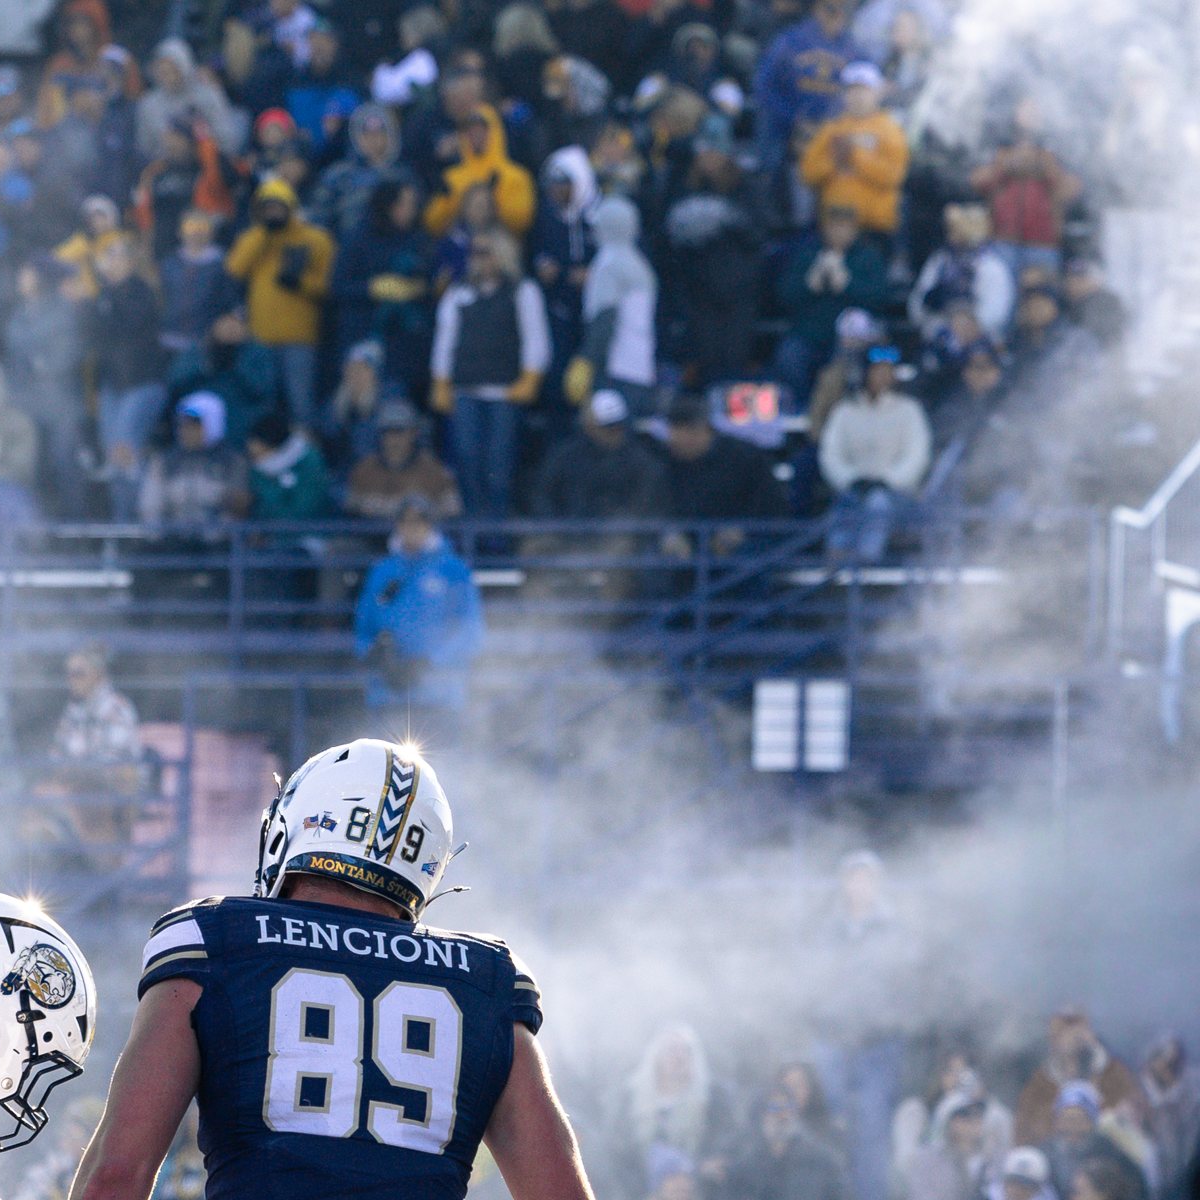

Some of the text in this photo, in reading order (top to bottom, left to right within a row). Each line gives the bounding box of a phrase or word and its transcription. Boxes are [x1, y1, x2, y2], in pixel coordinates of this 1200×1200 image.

[309, 856, 420, 907] MONTANA STATE
[255, 915, 470, 973] LENCIONI
[262, 967, 463, 1155] 89
